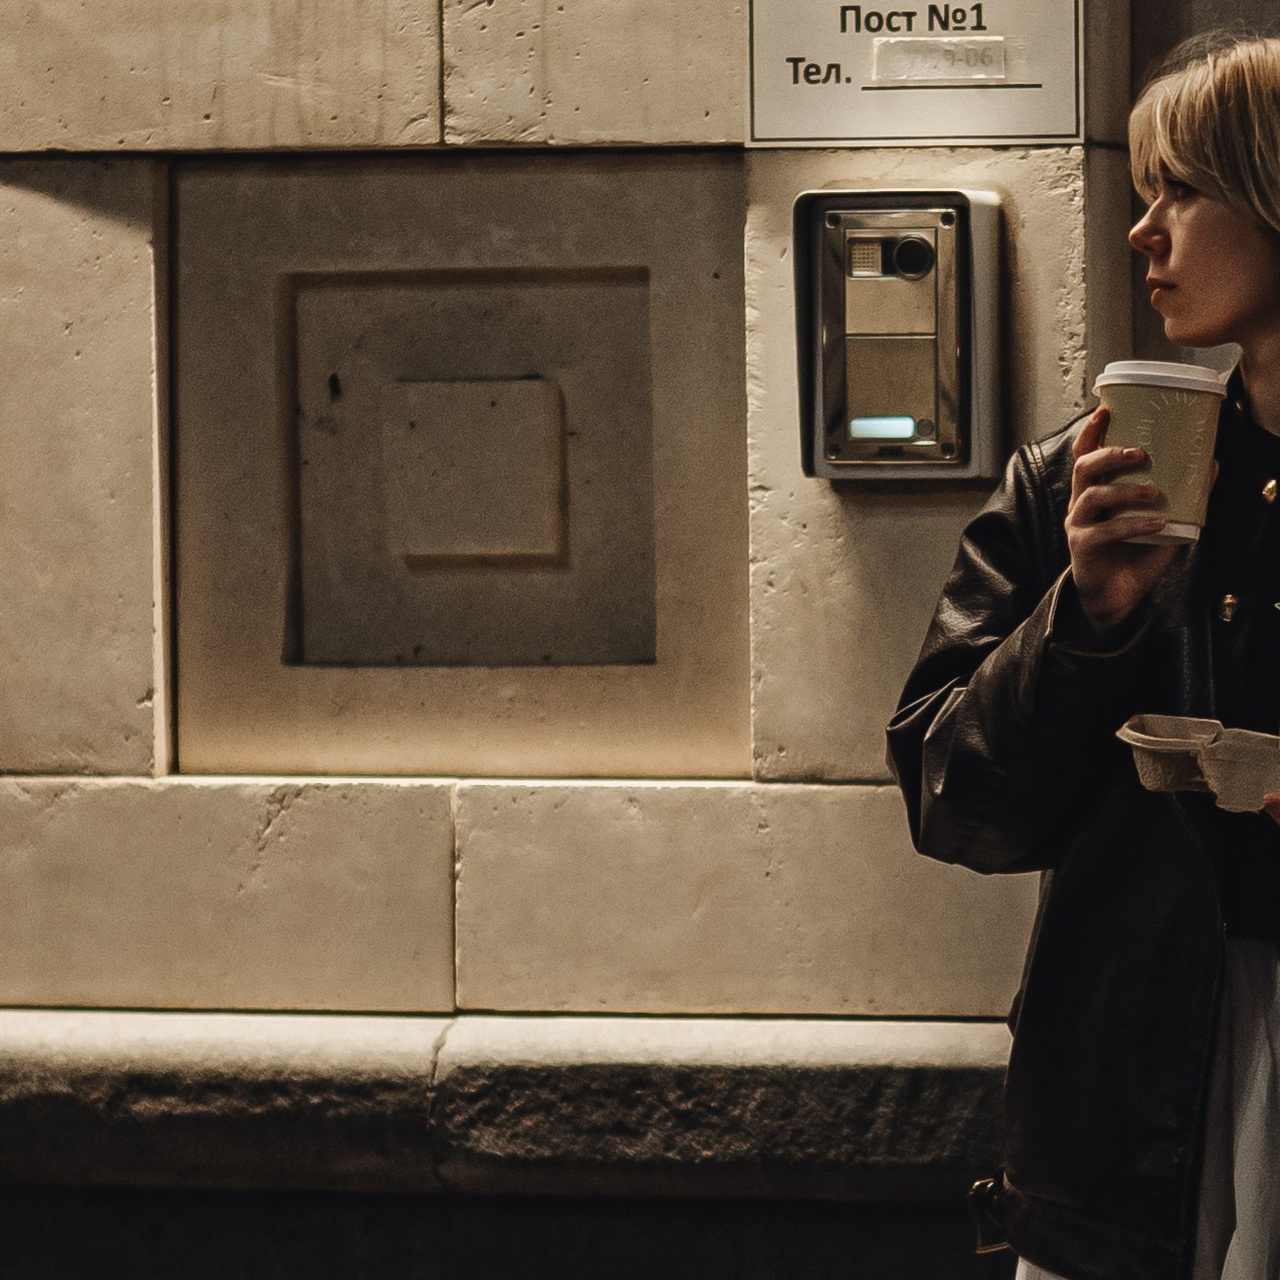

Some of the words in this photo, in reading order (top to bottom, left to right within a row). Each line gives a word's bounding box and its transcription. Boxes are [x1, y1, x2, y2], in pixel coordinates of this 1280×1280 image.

[840, 4, 917, 33] Пост
[927, 2, 988, 32] №1
[785, 56, 852, 85] Тел.
